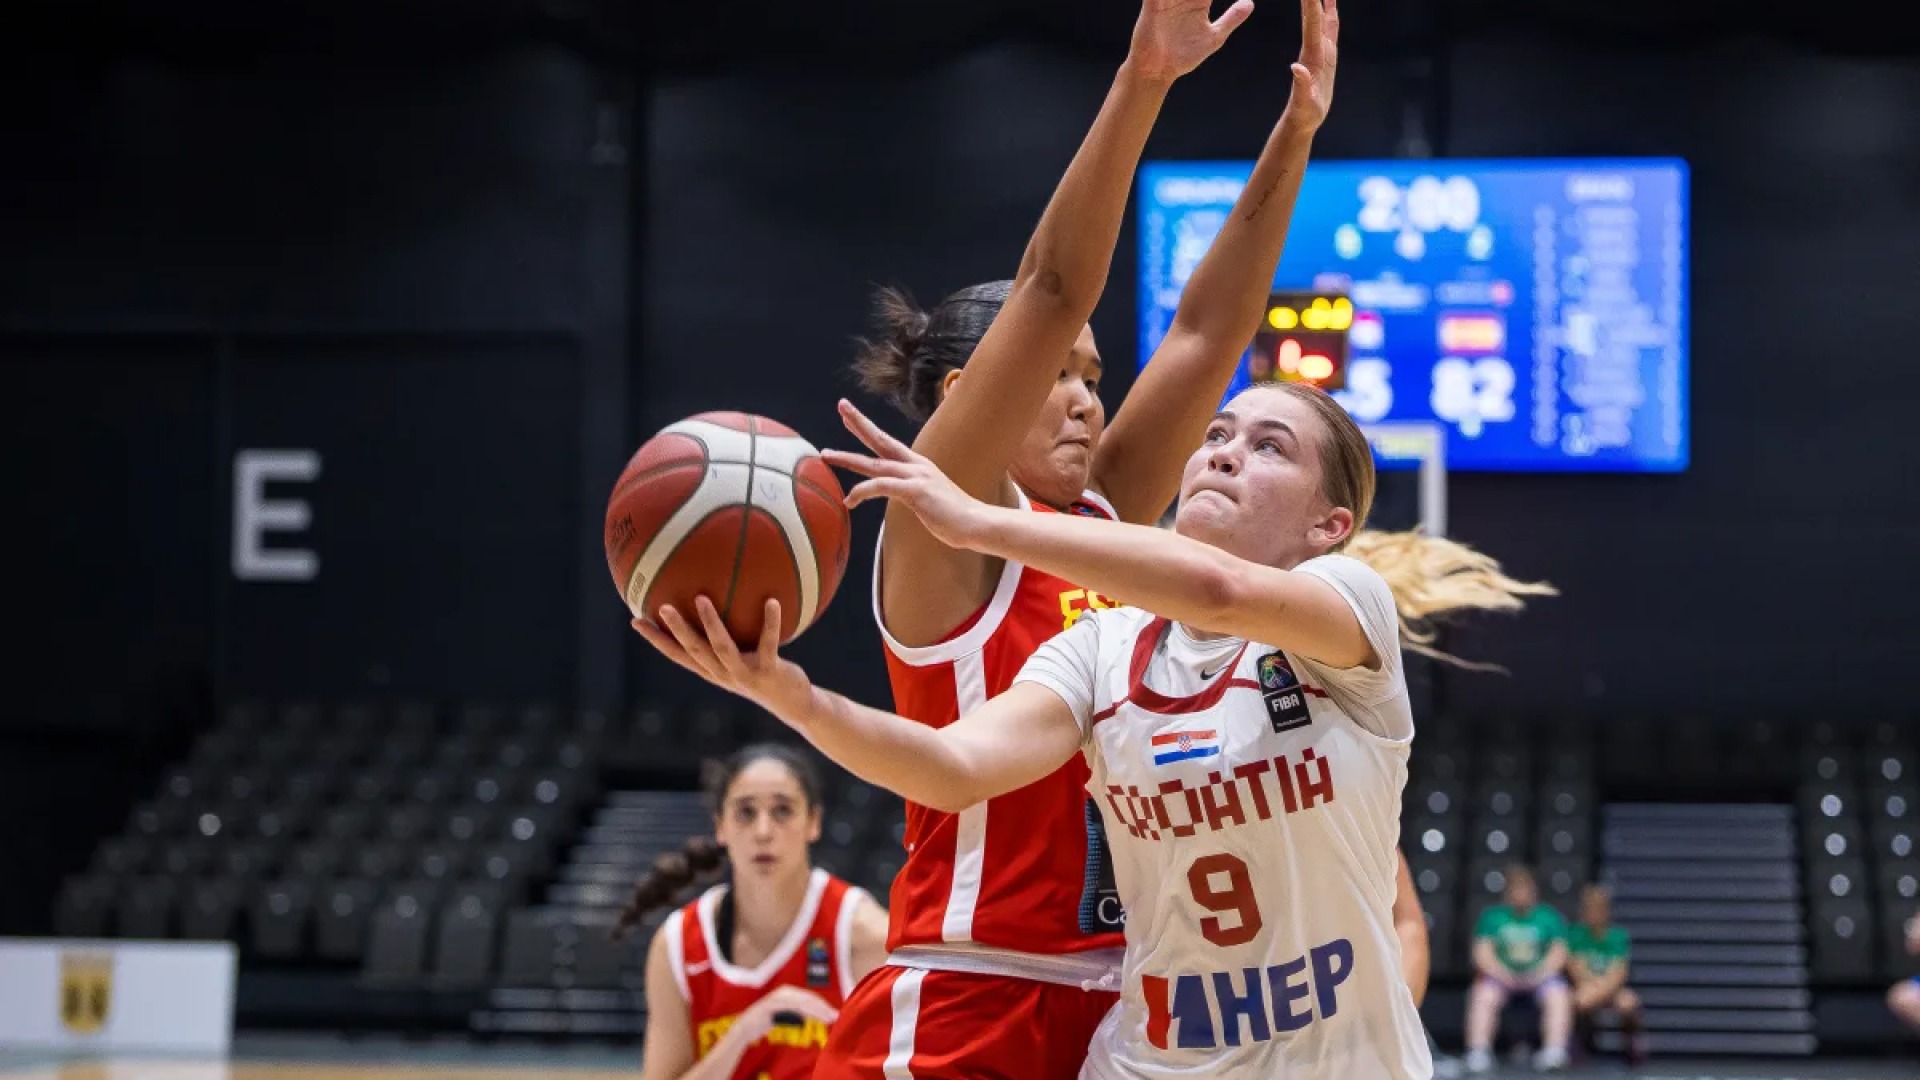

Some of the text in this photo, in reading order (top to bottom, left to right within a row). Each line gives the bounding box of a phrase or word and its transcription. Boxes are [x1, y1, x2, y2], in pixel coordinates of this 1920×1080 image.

[232, 449, 321, 581] E
[1271, 693, 1300, 713] FIBA
[1105, 747, 1336, 841] CROATIA
[1187, 852, 1263, 947] 9
